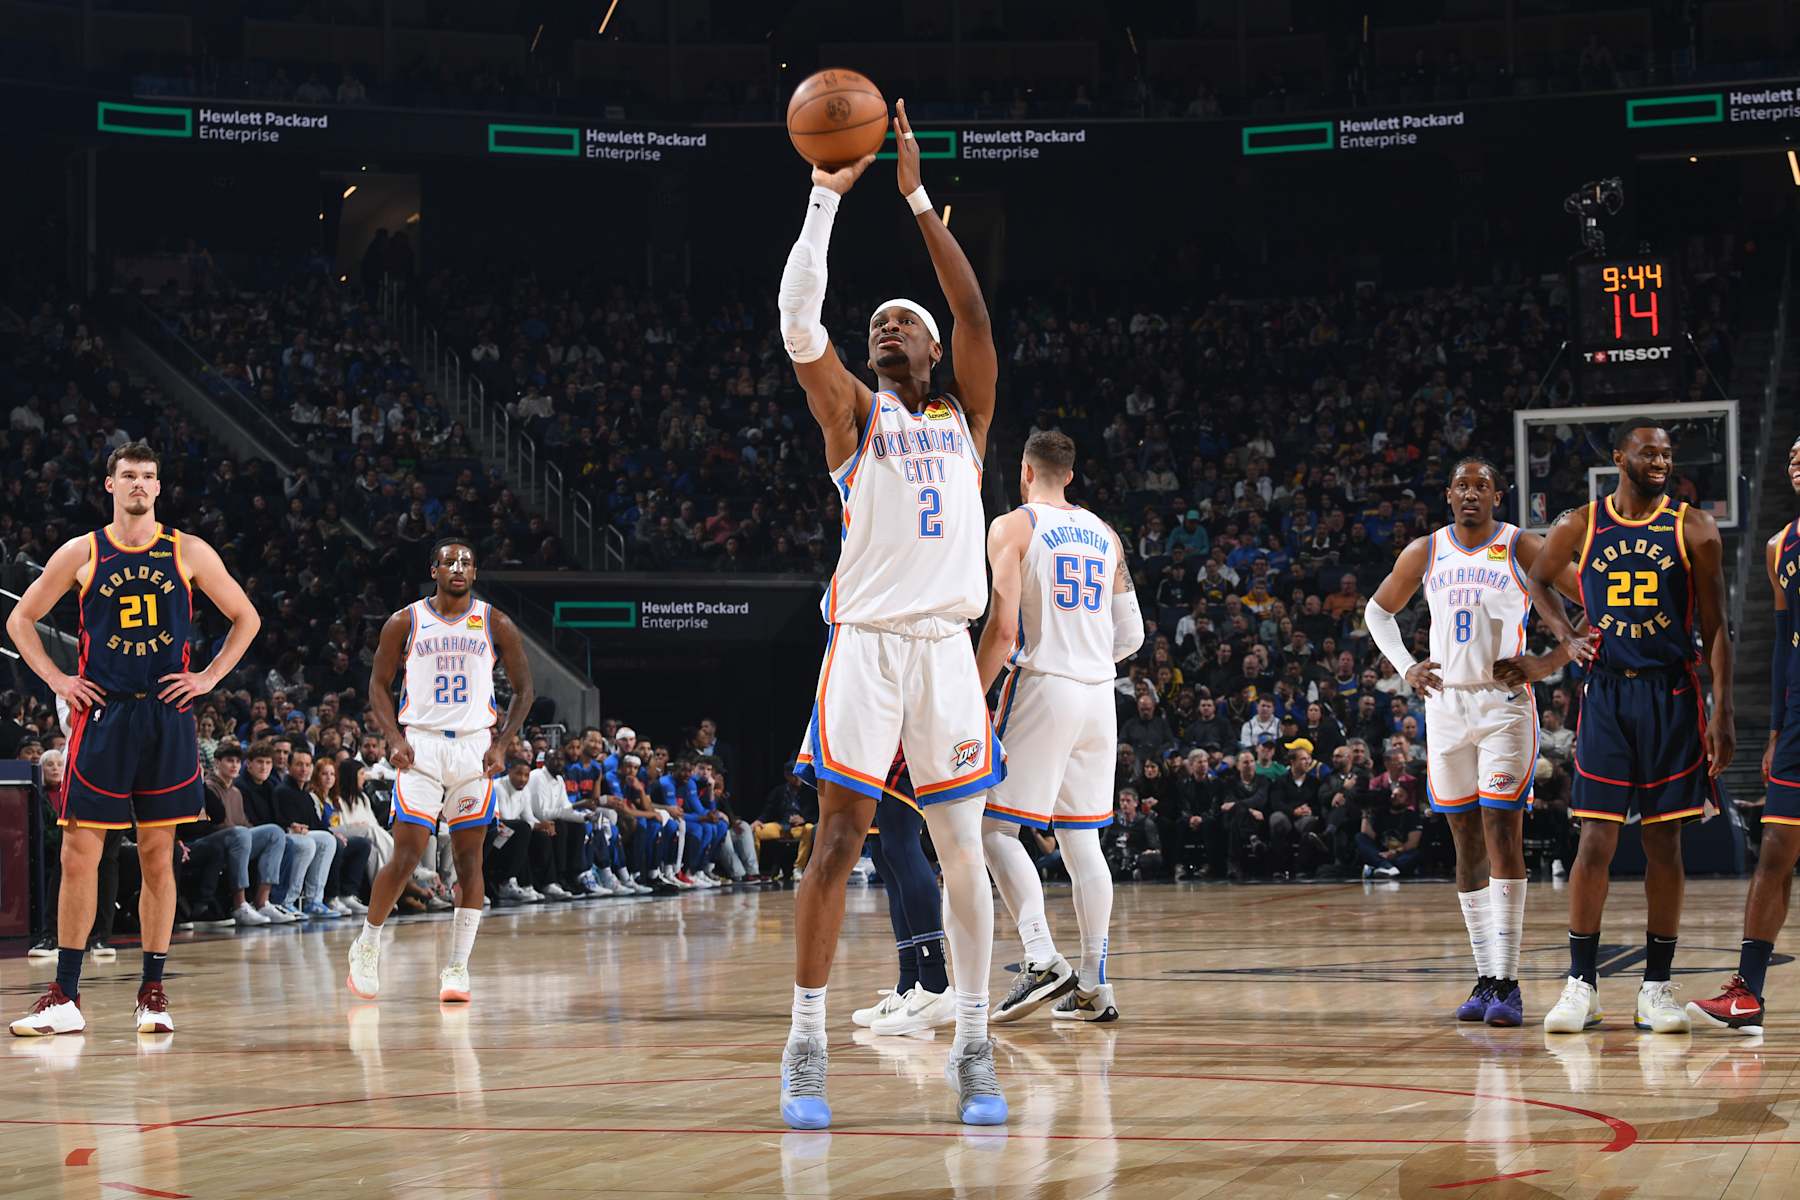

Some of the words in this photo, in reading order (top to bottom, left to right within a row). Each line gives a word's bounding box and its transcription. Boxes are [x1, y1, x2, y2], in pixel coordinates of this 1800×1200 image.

[1730, 88, 1793, 105] Hewlett
[200, 109, 262, 125] Hewlett
[265, 112, 328, 128] Packard
[1340, 117, 1400, 132] Hewlett
[1403, 112, 1464, 129] Packard
[1730, 105, 1800, 122] Enterpris
[200, 126, 280, 143] Enterprise
[586, 129, 644, 144] Hewlett
[648, 132, 706, 146] Packard
[963, 130, 1022, 143] Hewlett
[1026, 130, 1085, 143] Packard
[1340, 132, 1417, 148] Enterprise
[586, 145, 661, 161] Enterprise
[963, 146, 1039, 160] Enterprise
[1602, 264, 1662, 292] 9:44
[1614, 291, 1659, 339] 14
[1608, 347, 1672, 362] TISSOT
[871, 427, 965, 460] OKLAHOMA
[903, 456, 946, 484] CITY
[918, 485, 944, 539] 2
[1041, 526, 1109, 555] HARTENSTEIN
[1592, 538, 1675, 573] GOLDEN
[99, 565, 175, 598] GOLDEN
[1053, 553, 1106, 614] 55
[1430, 566, 1511, 593] OKLAHOMA
[1607, 571, 1659, 607] 22
[642, 601, 694, 614] Hewlett
[697, 601, 749, 614] Packard
[1448, 588, 1484, 607] CITY
[119, 593, 158, 629] 21
[642, 616, 709, 630] Enterprise
[1454, 607, 1474, 646] 8
[1598, 611, 1672, 639] STATE
[106, 630, 175, 656] STATE
[415, 635, 487, 658] OKLAHOMA
[436, 655, 467, 672] CITY
[434, 673, 469, 705] 22
